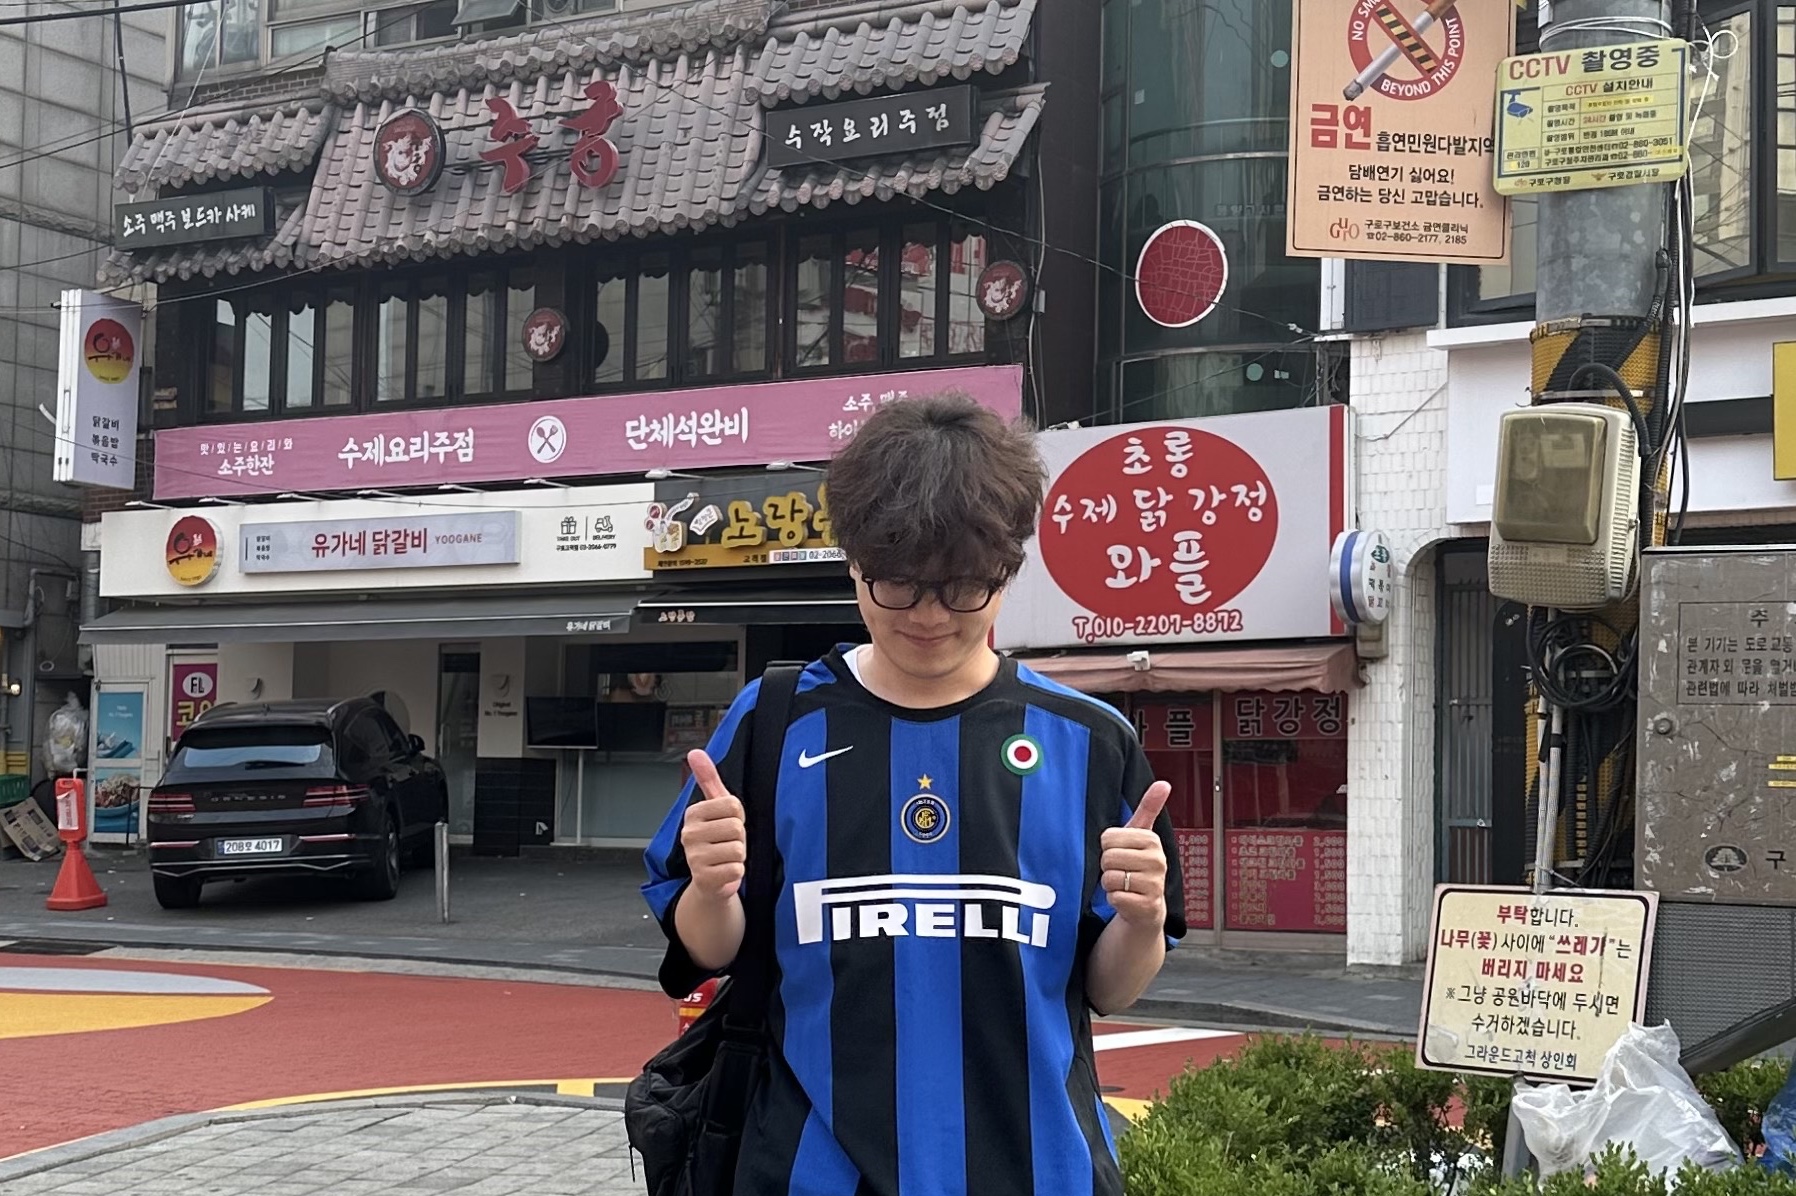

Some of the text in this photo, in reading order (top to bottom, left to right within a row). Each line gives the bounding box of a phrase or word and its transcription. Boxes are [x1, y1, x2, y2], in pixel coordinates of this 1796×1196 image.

[1352, 20, 1364, 41] NO
[1380, 17, 1461, 96] BEYOND THIS POINT
[1509, 45, 1660, 80] CCTV 촬영중
[1565, 78, 1653, 96] CCTV 설치안내
[1310, 103, 1372, 150] 금연
[1348, 164, 1454, 185] 담배연기 싫어요!
[1317, 185, 1484, 209] 금연하는 당신 고맙습니다.
[123, 203, 256, 237] 소주 맥주 보드카 사케
[1364, 219, 1469, 234] 구로구보건소 금연클리닉
[1445, 234, 1468, 245] 2185
[92, 415, 120, 430] 닭갈비
[624, 406, 749, 450] 단체석완비
[337, 427, 475, 469] 수제요리주점
[1122, 430, 1194, 478] 초롱
[217, 453, 275, 477] 소주한잔
[1052, 493, 1117, 534] 수제
[312, 527, 482, 558] 유가네 닭갈비 YOOGANE
[1105, 530, 1212, 605] 와플
[1705, 636, 1738, 653] 기기는
[1745, 637, 1767, 651] 도로
[1687, 658, 1720, 676] 관계자
[1723, 658, 1734, 676] 외
[1686, 680, 1731, 698] 관련법에
[1737, 680, 1760, 698] 따라
[1234, 696, 1342, 736] 닭강정
[254, 839, 281, 851] 4017
[1766, 850, 1787, 870] 구
[793, 874, 1057, 948] PIRELLI
[1497, 904, 1579, 928] 부탁합니다.
[1440, 928, 1498, 951] 나무(꽃)
[1501, 932, 1546, 954] 사이에
[1481, 957, 1585, 984] 버리지 마세요
[1572, 991, 1620, 1016] 두시면
[1471, 1013, 1581, 1040] 수거하겠습니다.
[1464, 1044, 1578, 1072] 그라운드고척 상인회
